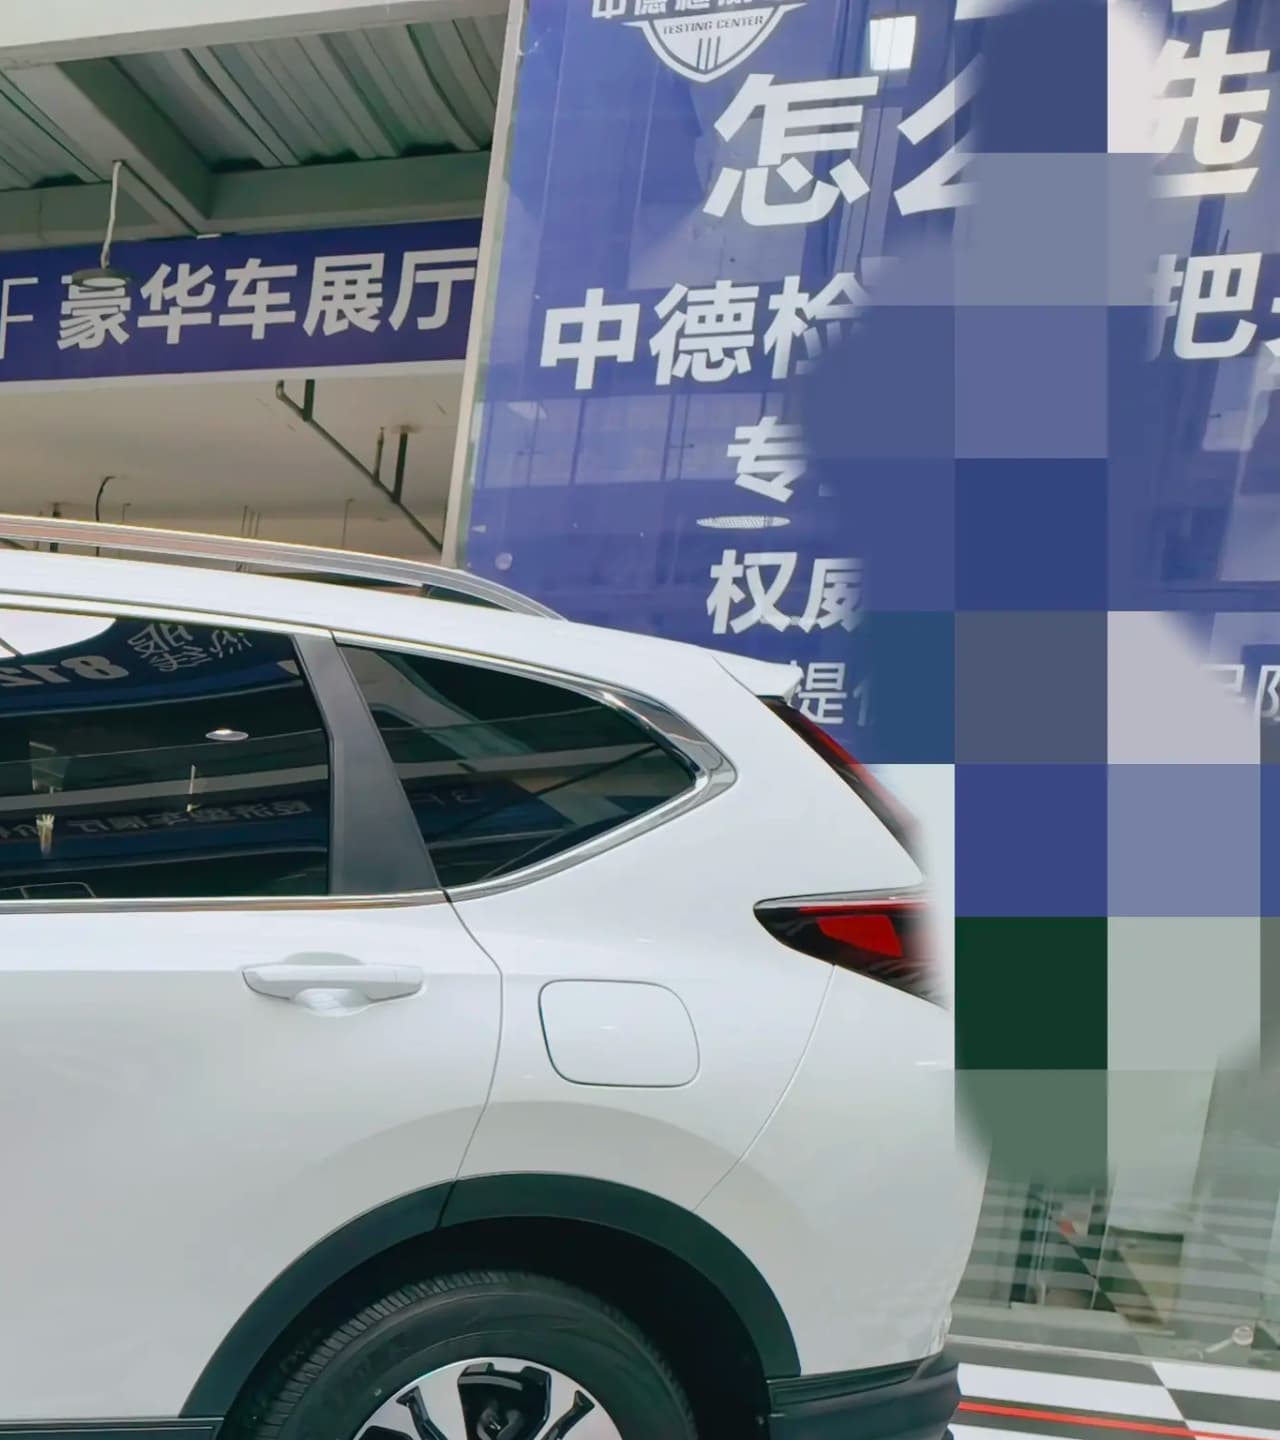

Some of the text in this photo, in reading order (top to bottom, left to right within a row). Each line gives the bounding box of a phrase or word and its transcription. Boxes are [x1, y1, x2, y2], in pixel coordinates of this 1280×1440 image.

[663, 15, 764, 35] TESTING CENTER
[56, 246, 478, 351] 豪华车展厅
[1150, 252, 1280, 361] 把
